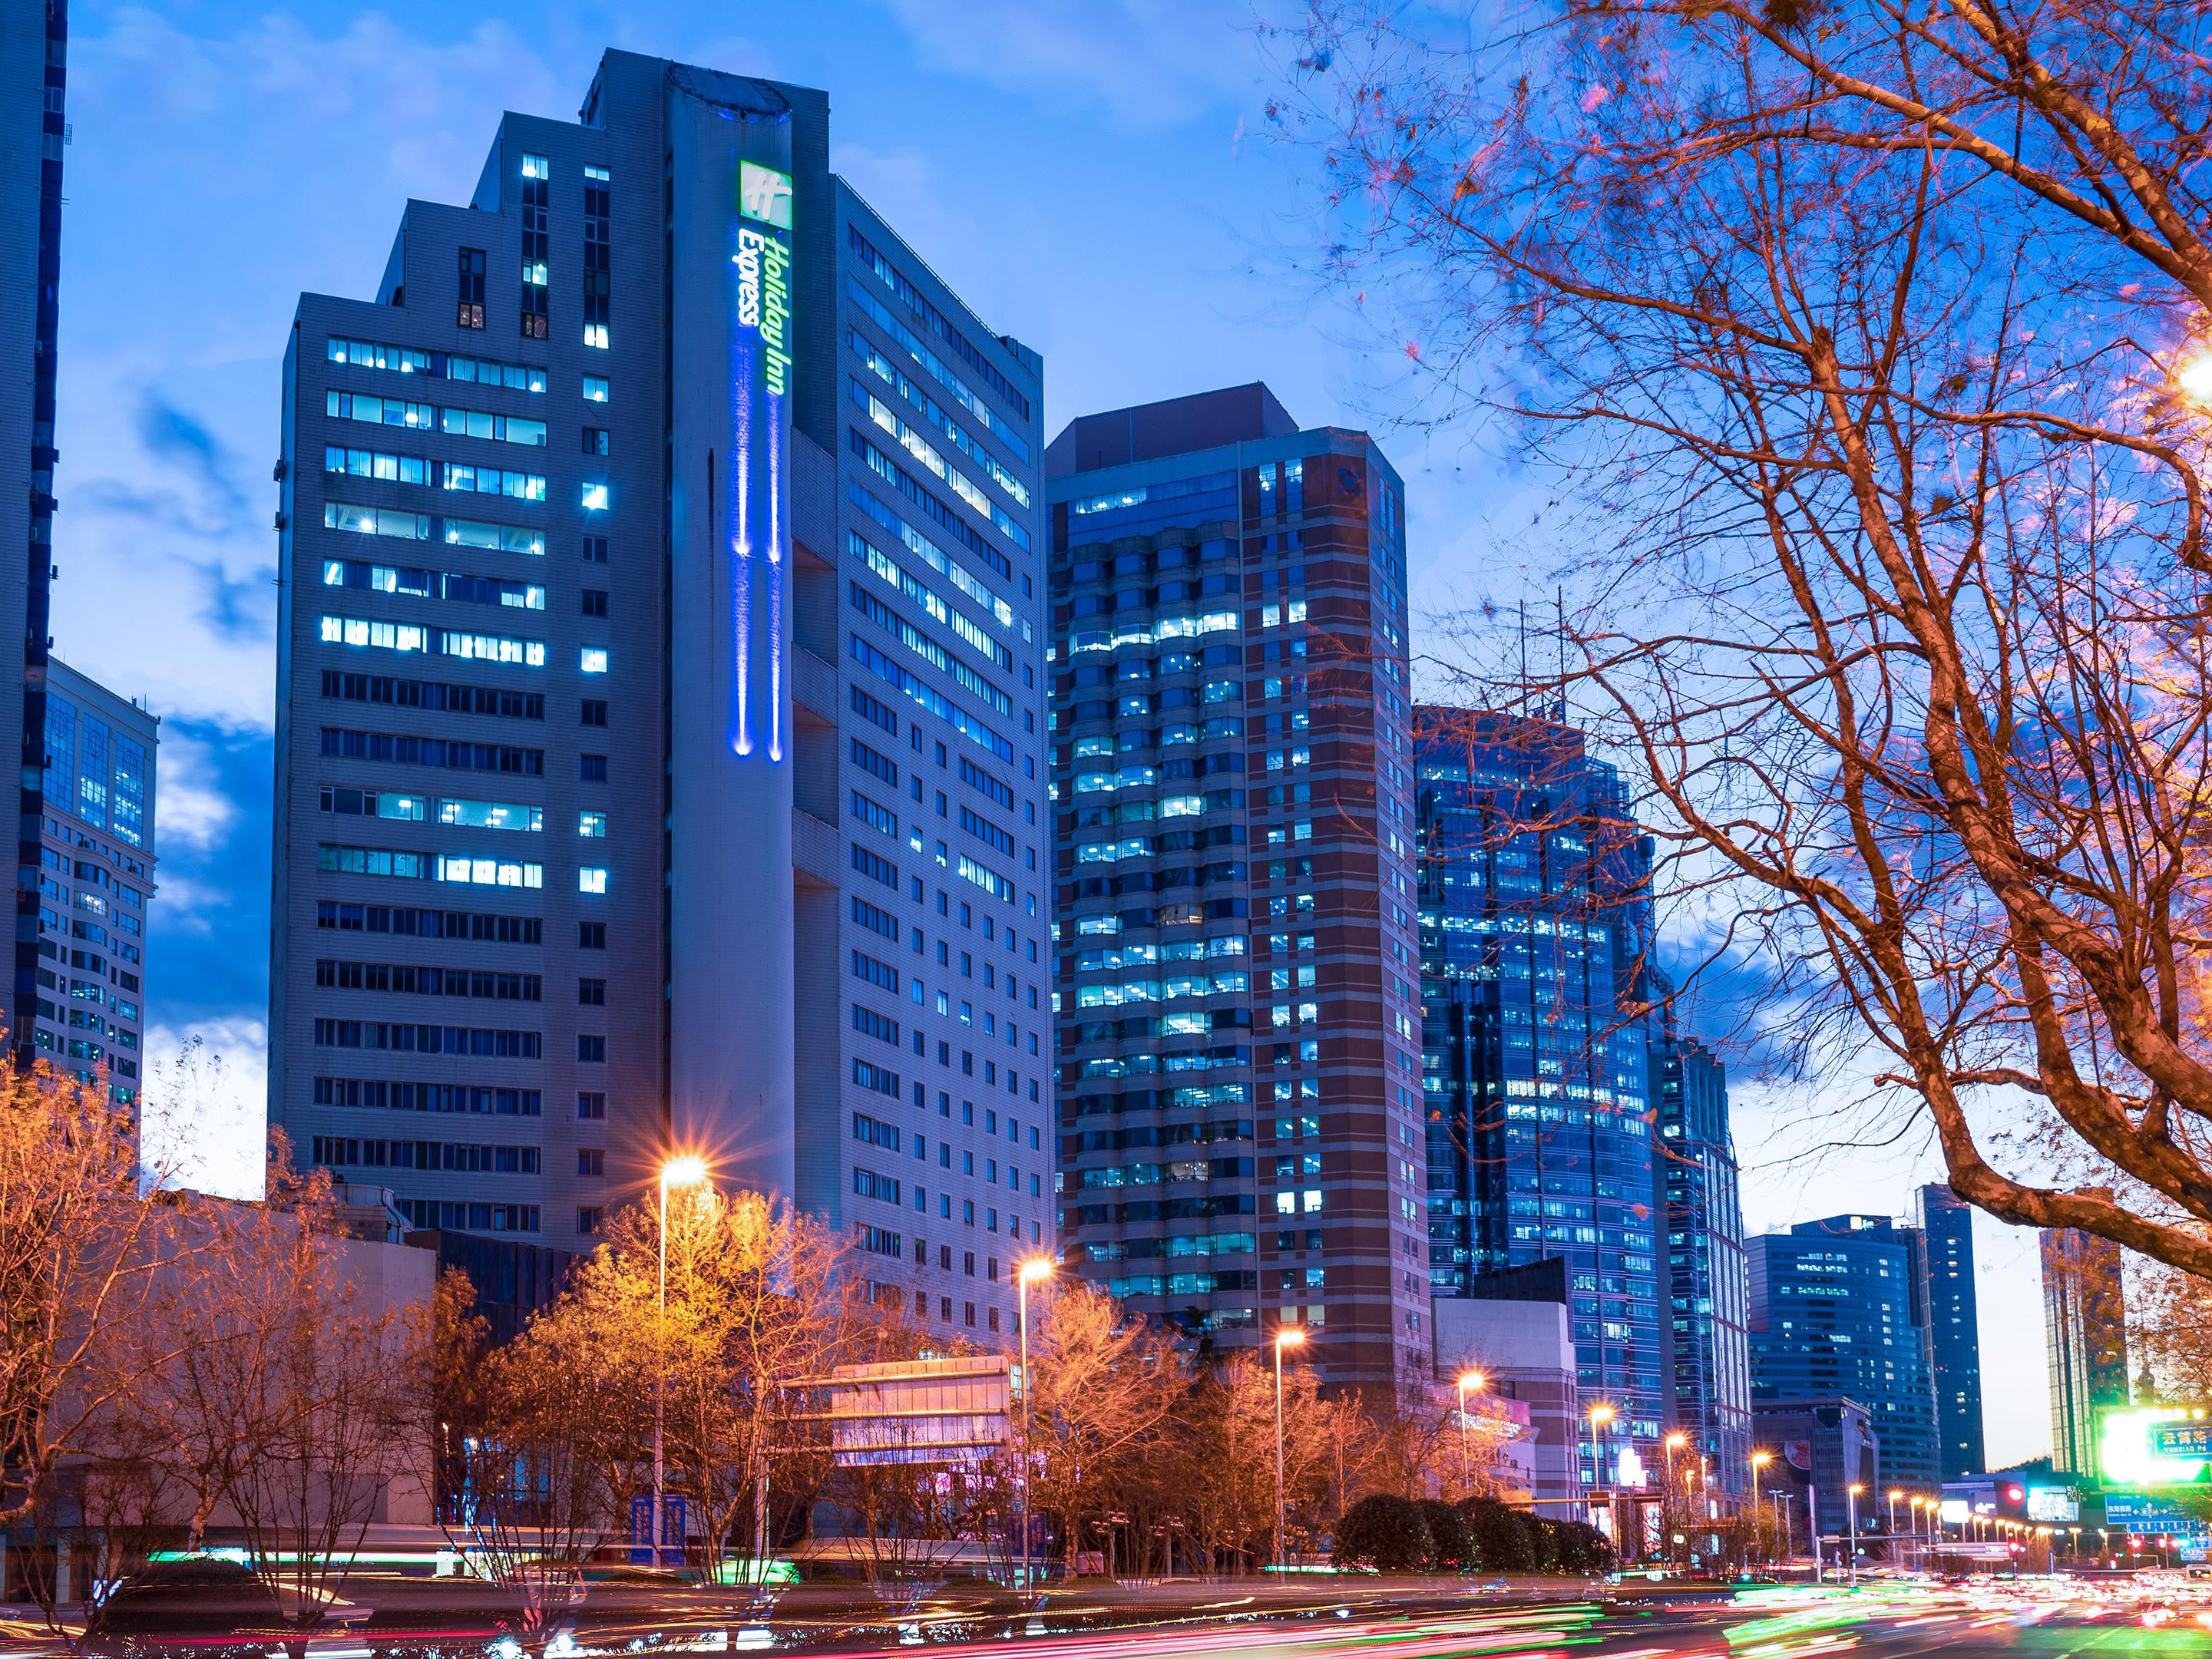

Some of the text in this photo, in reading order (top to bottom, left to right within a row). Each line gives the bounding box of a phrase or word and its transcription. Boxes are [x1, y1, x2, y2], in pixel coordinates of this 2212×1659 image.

[732, 228, 764, 327] Express
[759, 236, 792, 395] Holiday Inn
